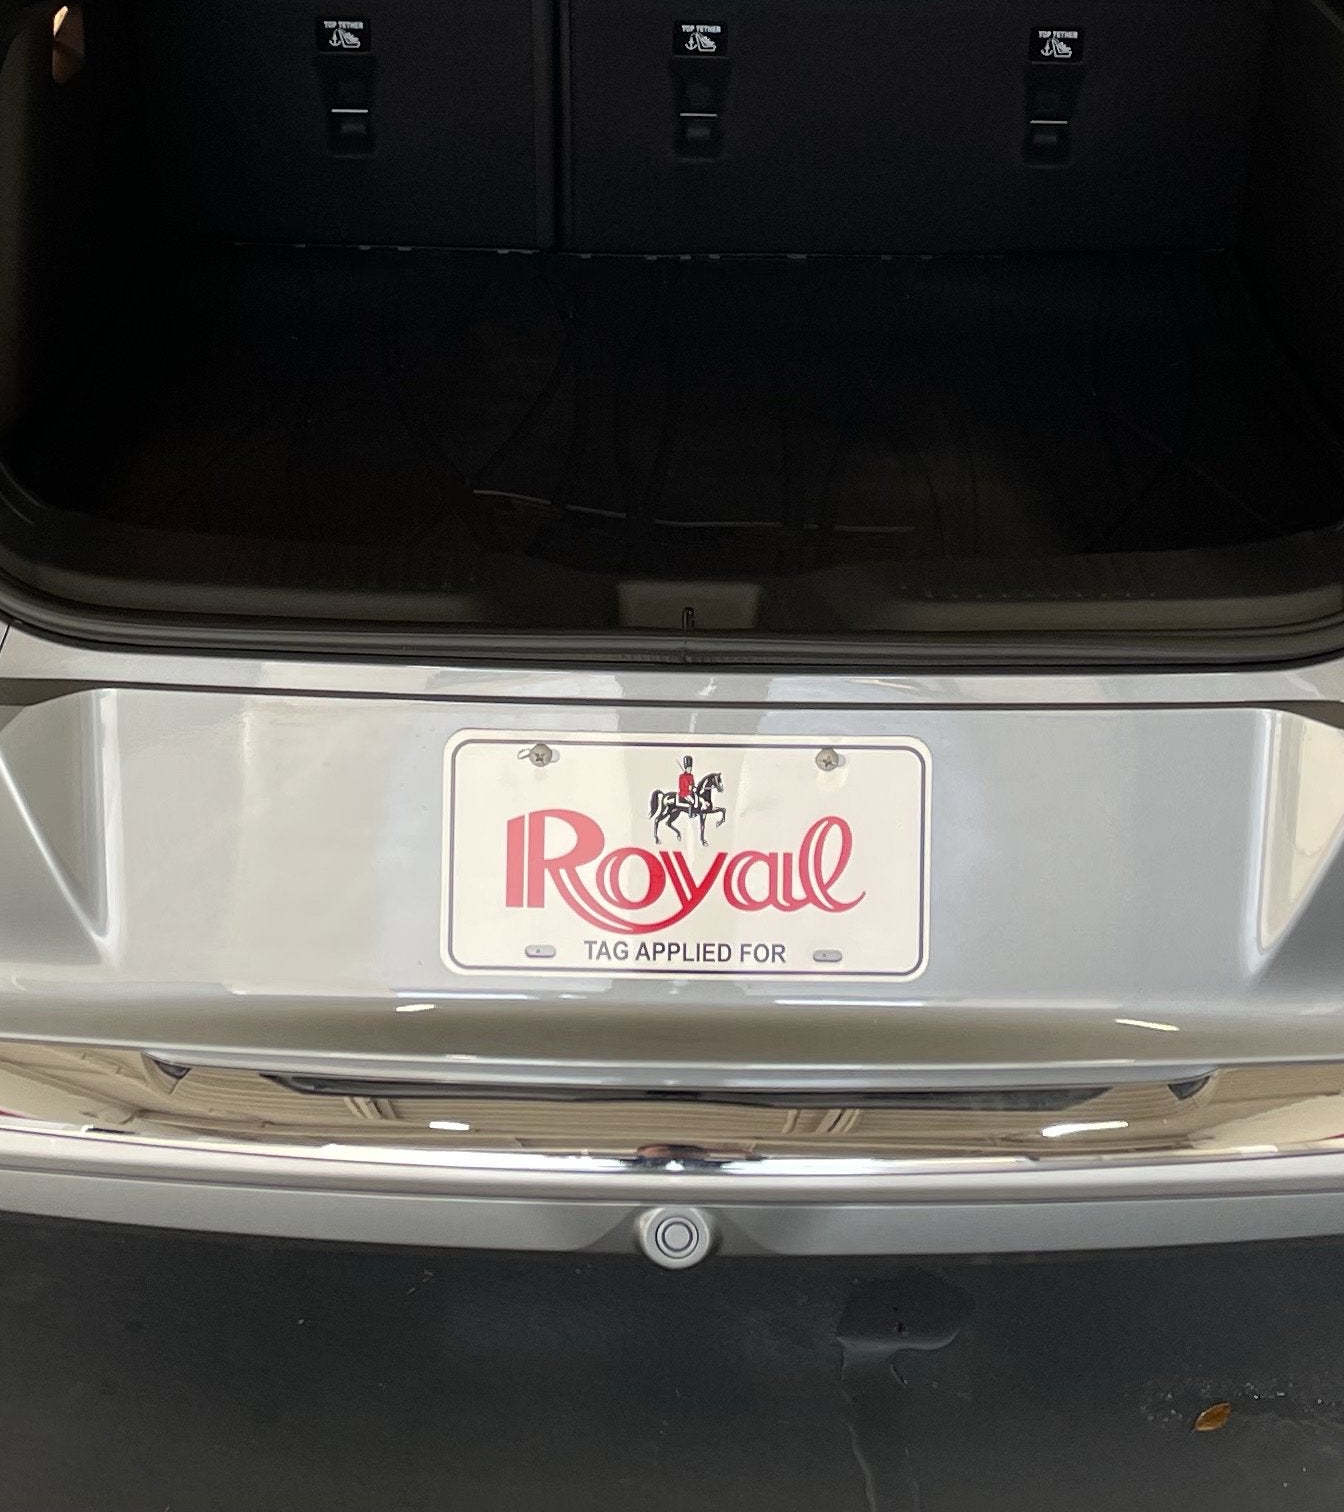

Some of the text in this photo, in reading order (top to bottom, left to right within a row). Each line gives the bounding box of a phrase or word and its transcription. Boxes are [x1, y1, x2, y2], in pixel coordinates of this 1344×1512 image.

[323, 20, 337, 29] TOP
[681, 24, 695, 33] TOP
[1038, 30, 1052, 39] TOP
[505, 808, 867, 935] Royal
[583, 940, 787, 964] TAG APPLIED FOR
